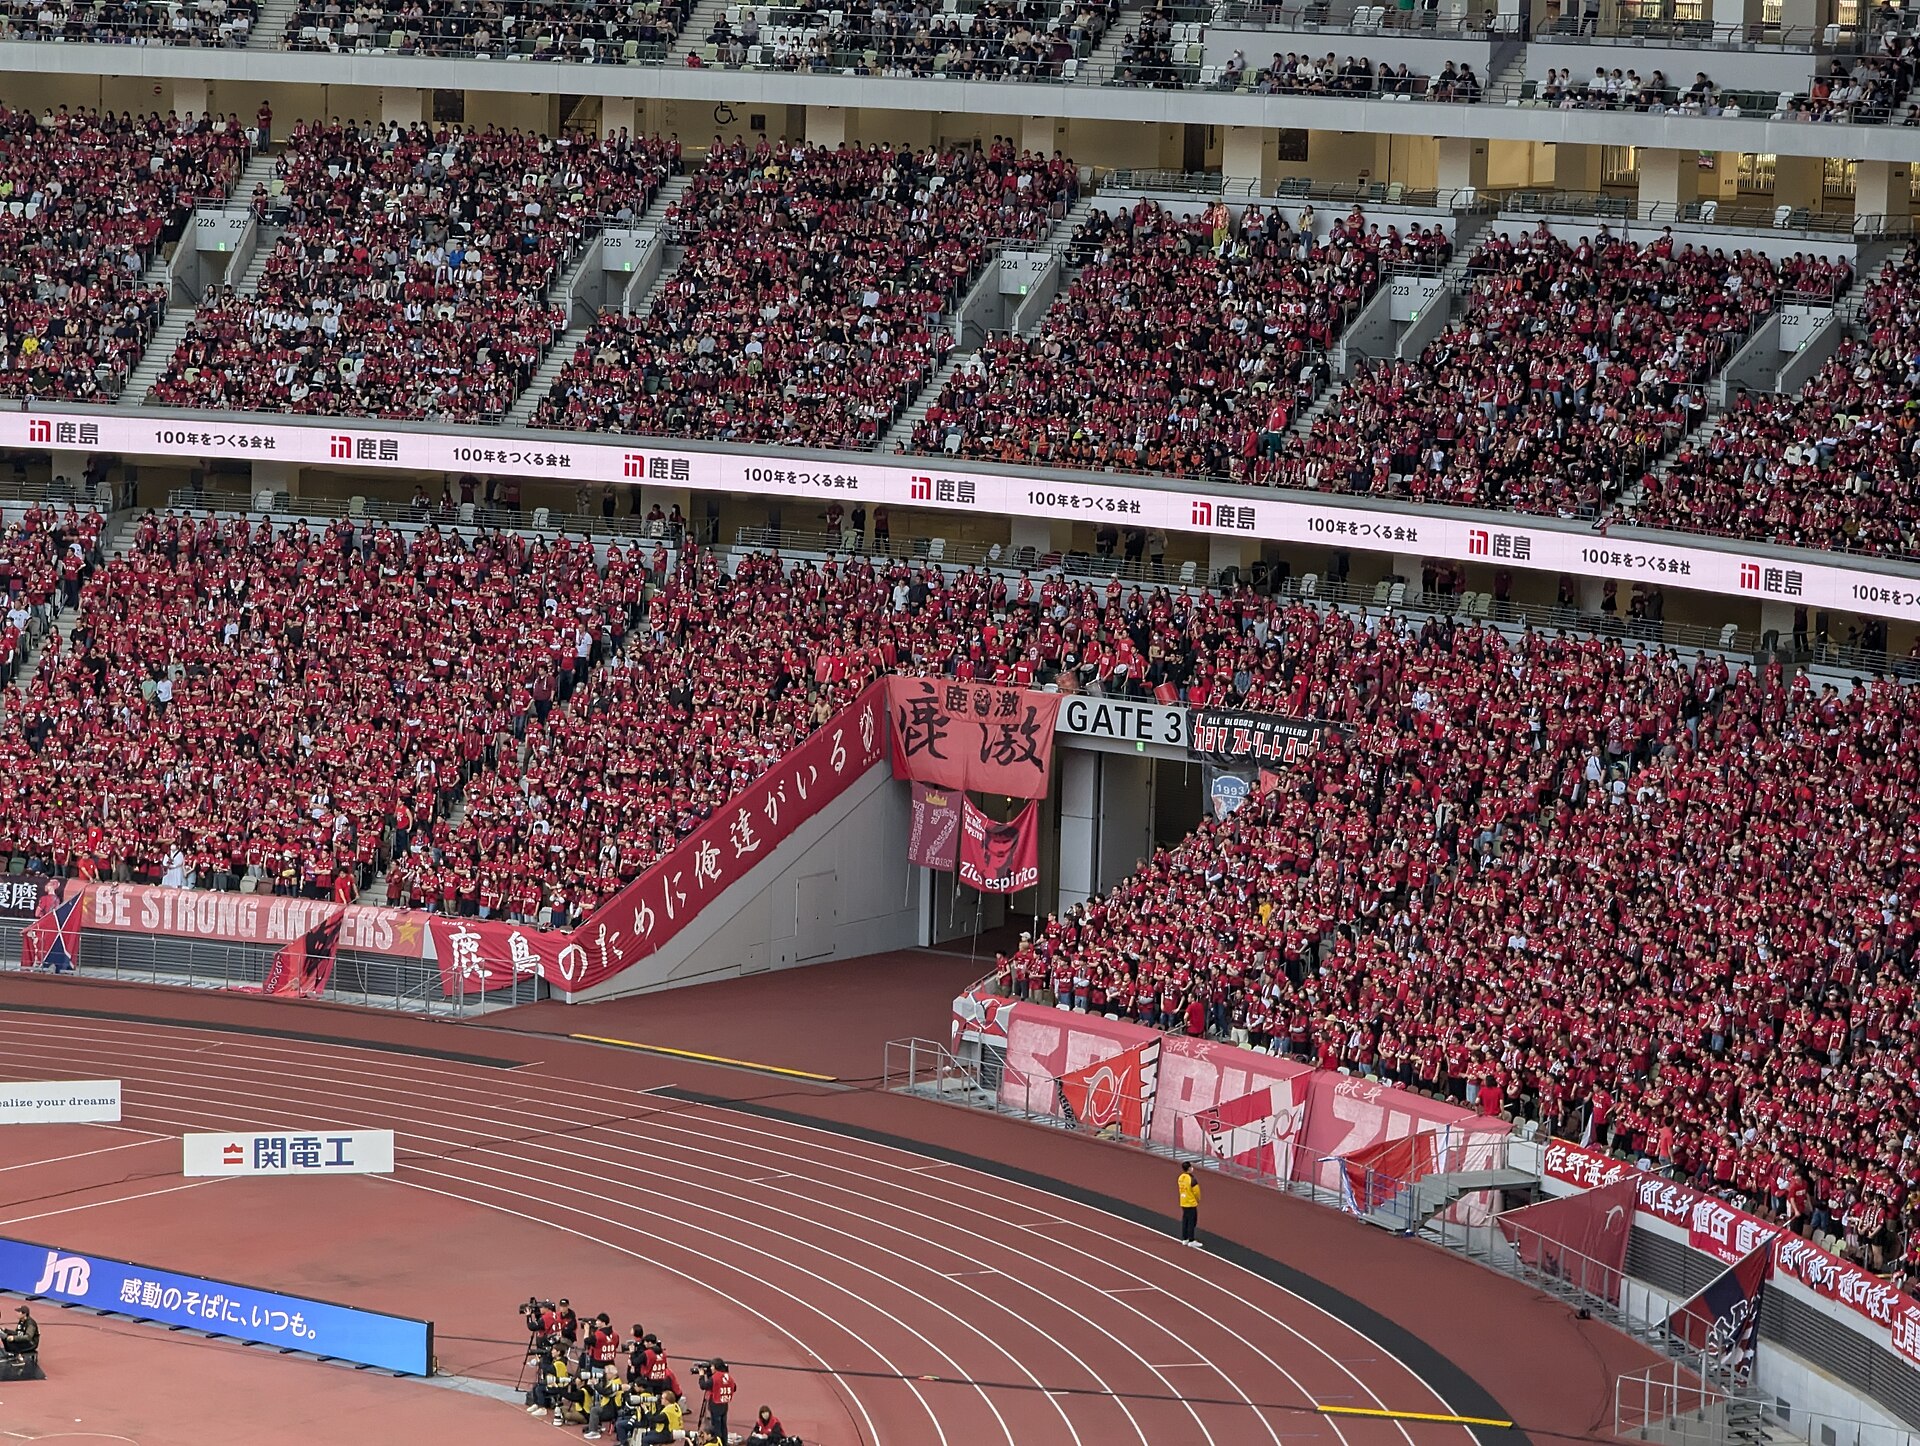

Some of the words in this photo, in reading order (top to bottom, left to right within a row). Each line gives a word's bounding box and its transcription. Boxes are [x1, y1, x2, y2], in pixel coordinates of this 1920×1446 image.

[197, 218, 215, 228] 226
[604, 238, 621, 247] 225
[1001, 260, 1018, 270] 224
[1392, 286, 1409, 296] 223
[1422, 287, 1439, 298] 22
[1781, 314, 1798, 325] 222
[1812, 317, 1828, 327] 22
[56, 421, 99, 445] 鹿島
[155, 431, 276, 449] 100年をつくる会社
[356, 438, 399, 462] 鹿島
[453, 448, 571, 468] 100年をつくる会社
[649, 457, 690, 481] 鹿島
[743, 468, 858, 489] 100年をつくる会社
[936, 479, 976, 504] 鹿島
[1027, 491, 1141, 514] 100年をつくる会社
[1216, 505, 1256, 531] 鹿島
[1307, 517, 1418, 542] 100年をつくる会社
[1492, 533, 1531, 560] 鹿島
[1581, 548, 1691, 575] 100年をつくる会社
[1764, 567, 1803, 596] 鹿島
[946, 685, 970, 714] 鹿
[994, 690, 1020, 717] 激
[1067, 700, 1153, 741] GATE
[1164, 712, 1182, 743] 3
[1207, 717, 1220, 725] ALL
[1256, 722, 1271, 731] FOR
[1274, 725, 1308, 737] ANTLERS
[1216, 784, 1245, 796] 1993
[985, 867, 1038, 892] espirito
[95, 885, 134, 926] BE
[141, 888, 259, 938] STRONG
[36, 1099, 66, 1109] your
[69, 1097, 116, 1106] dreams
[253, 1137, 355, 1169] 関電工
[1636, 1176, 1694, 1222] 間隼斗
[1692, 1200, 1736, 1245] 植田
[35, 1251, 91, 1296] JTB
[119, 1278, 317, 1340] 感動のそばに、いつも。
